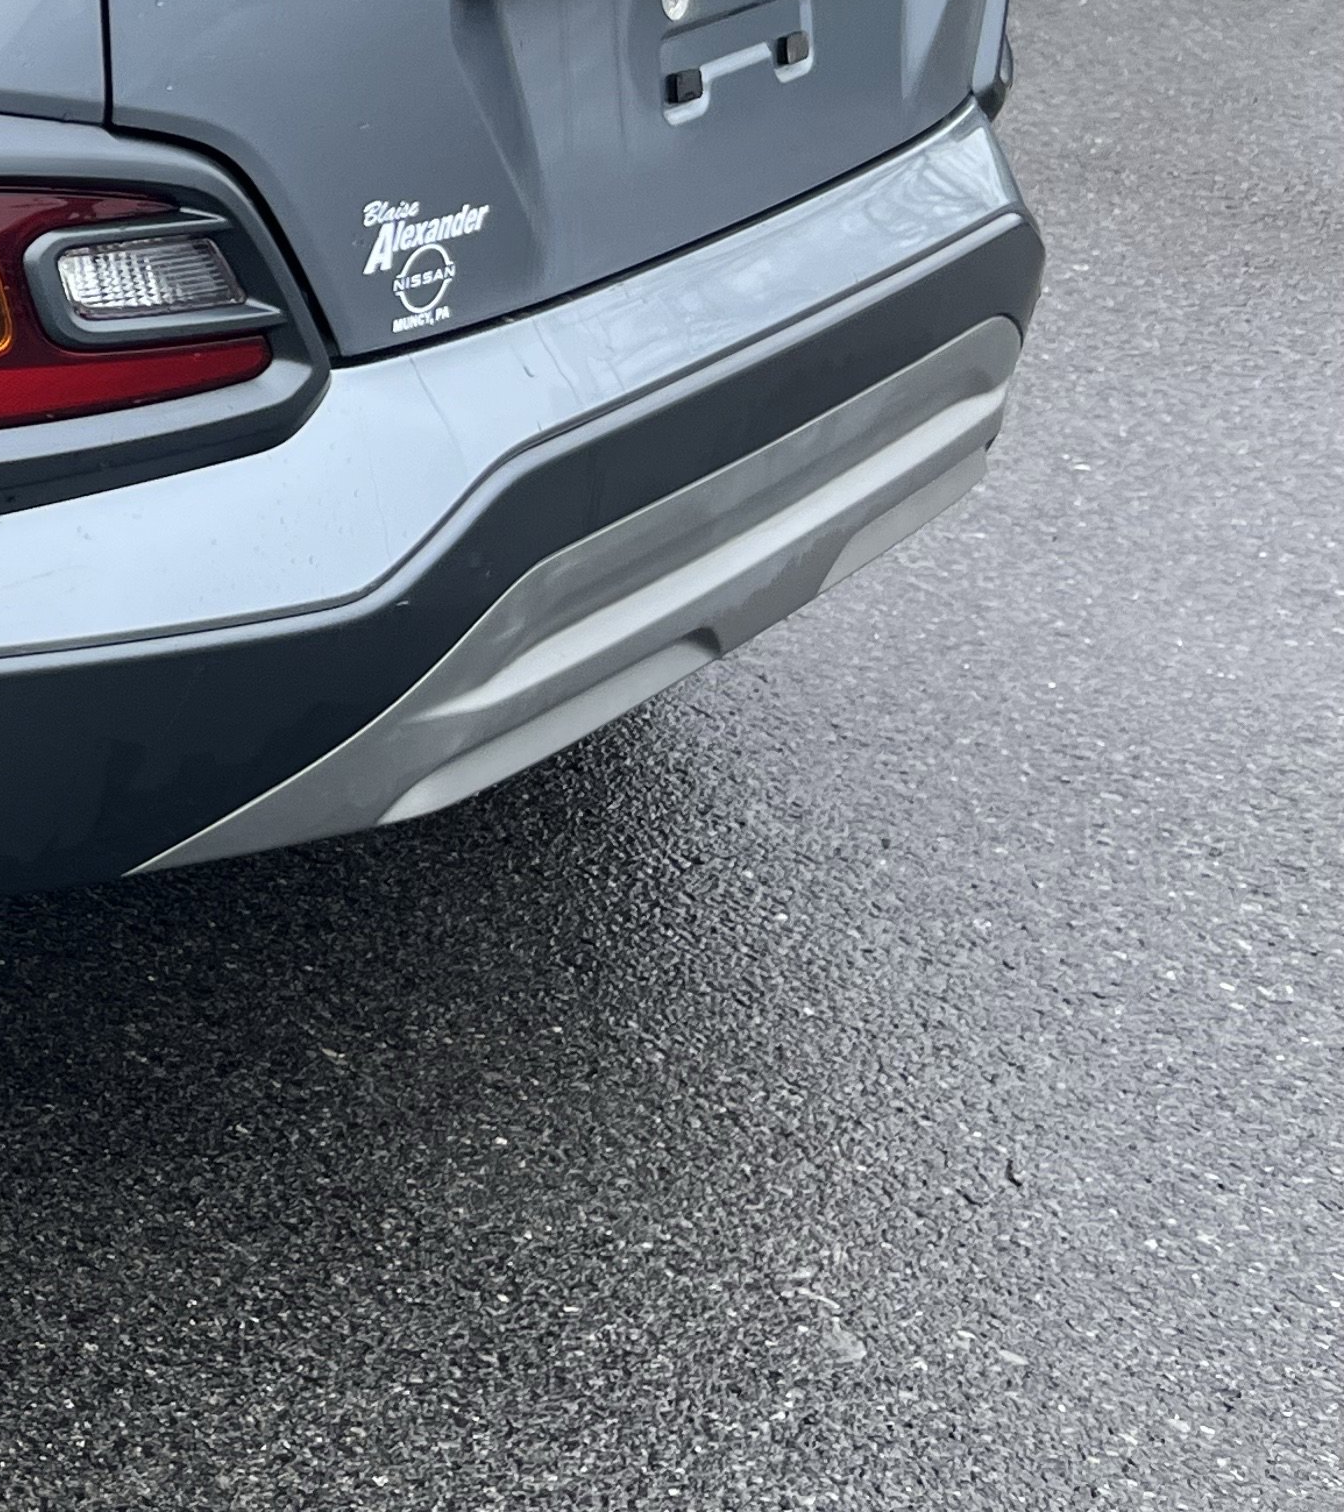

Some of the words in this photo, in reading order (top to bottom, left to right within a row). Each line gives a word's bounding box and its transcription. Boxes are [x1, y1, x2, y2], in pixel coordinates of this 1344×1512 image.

[363, 200, 421, 228] Blaise
[362, 203, 491, 276] Alexander
[392, 264, 456, 292] NISSAN
[435, 305, 450, 322] PA
